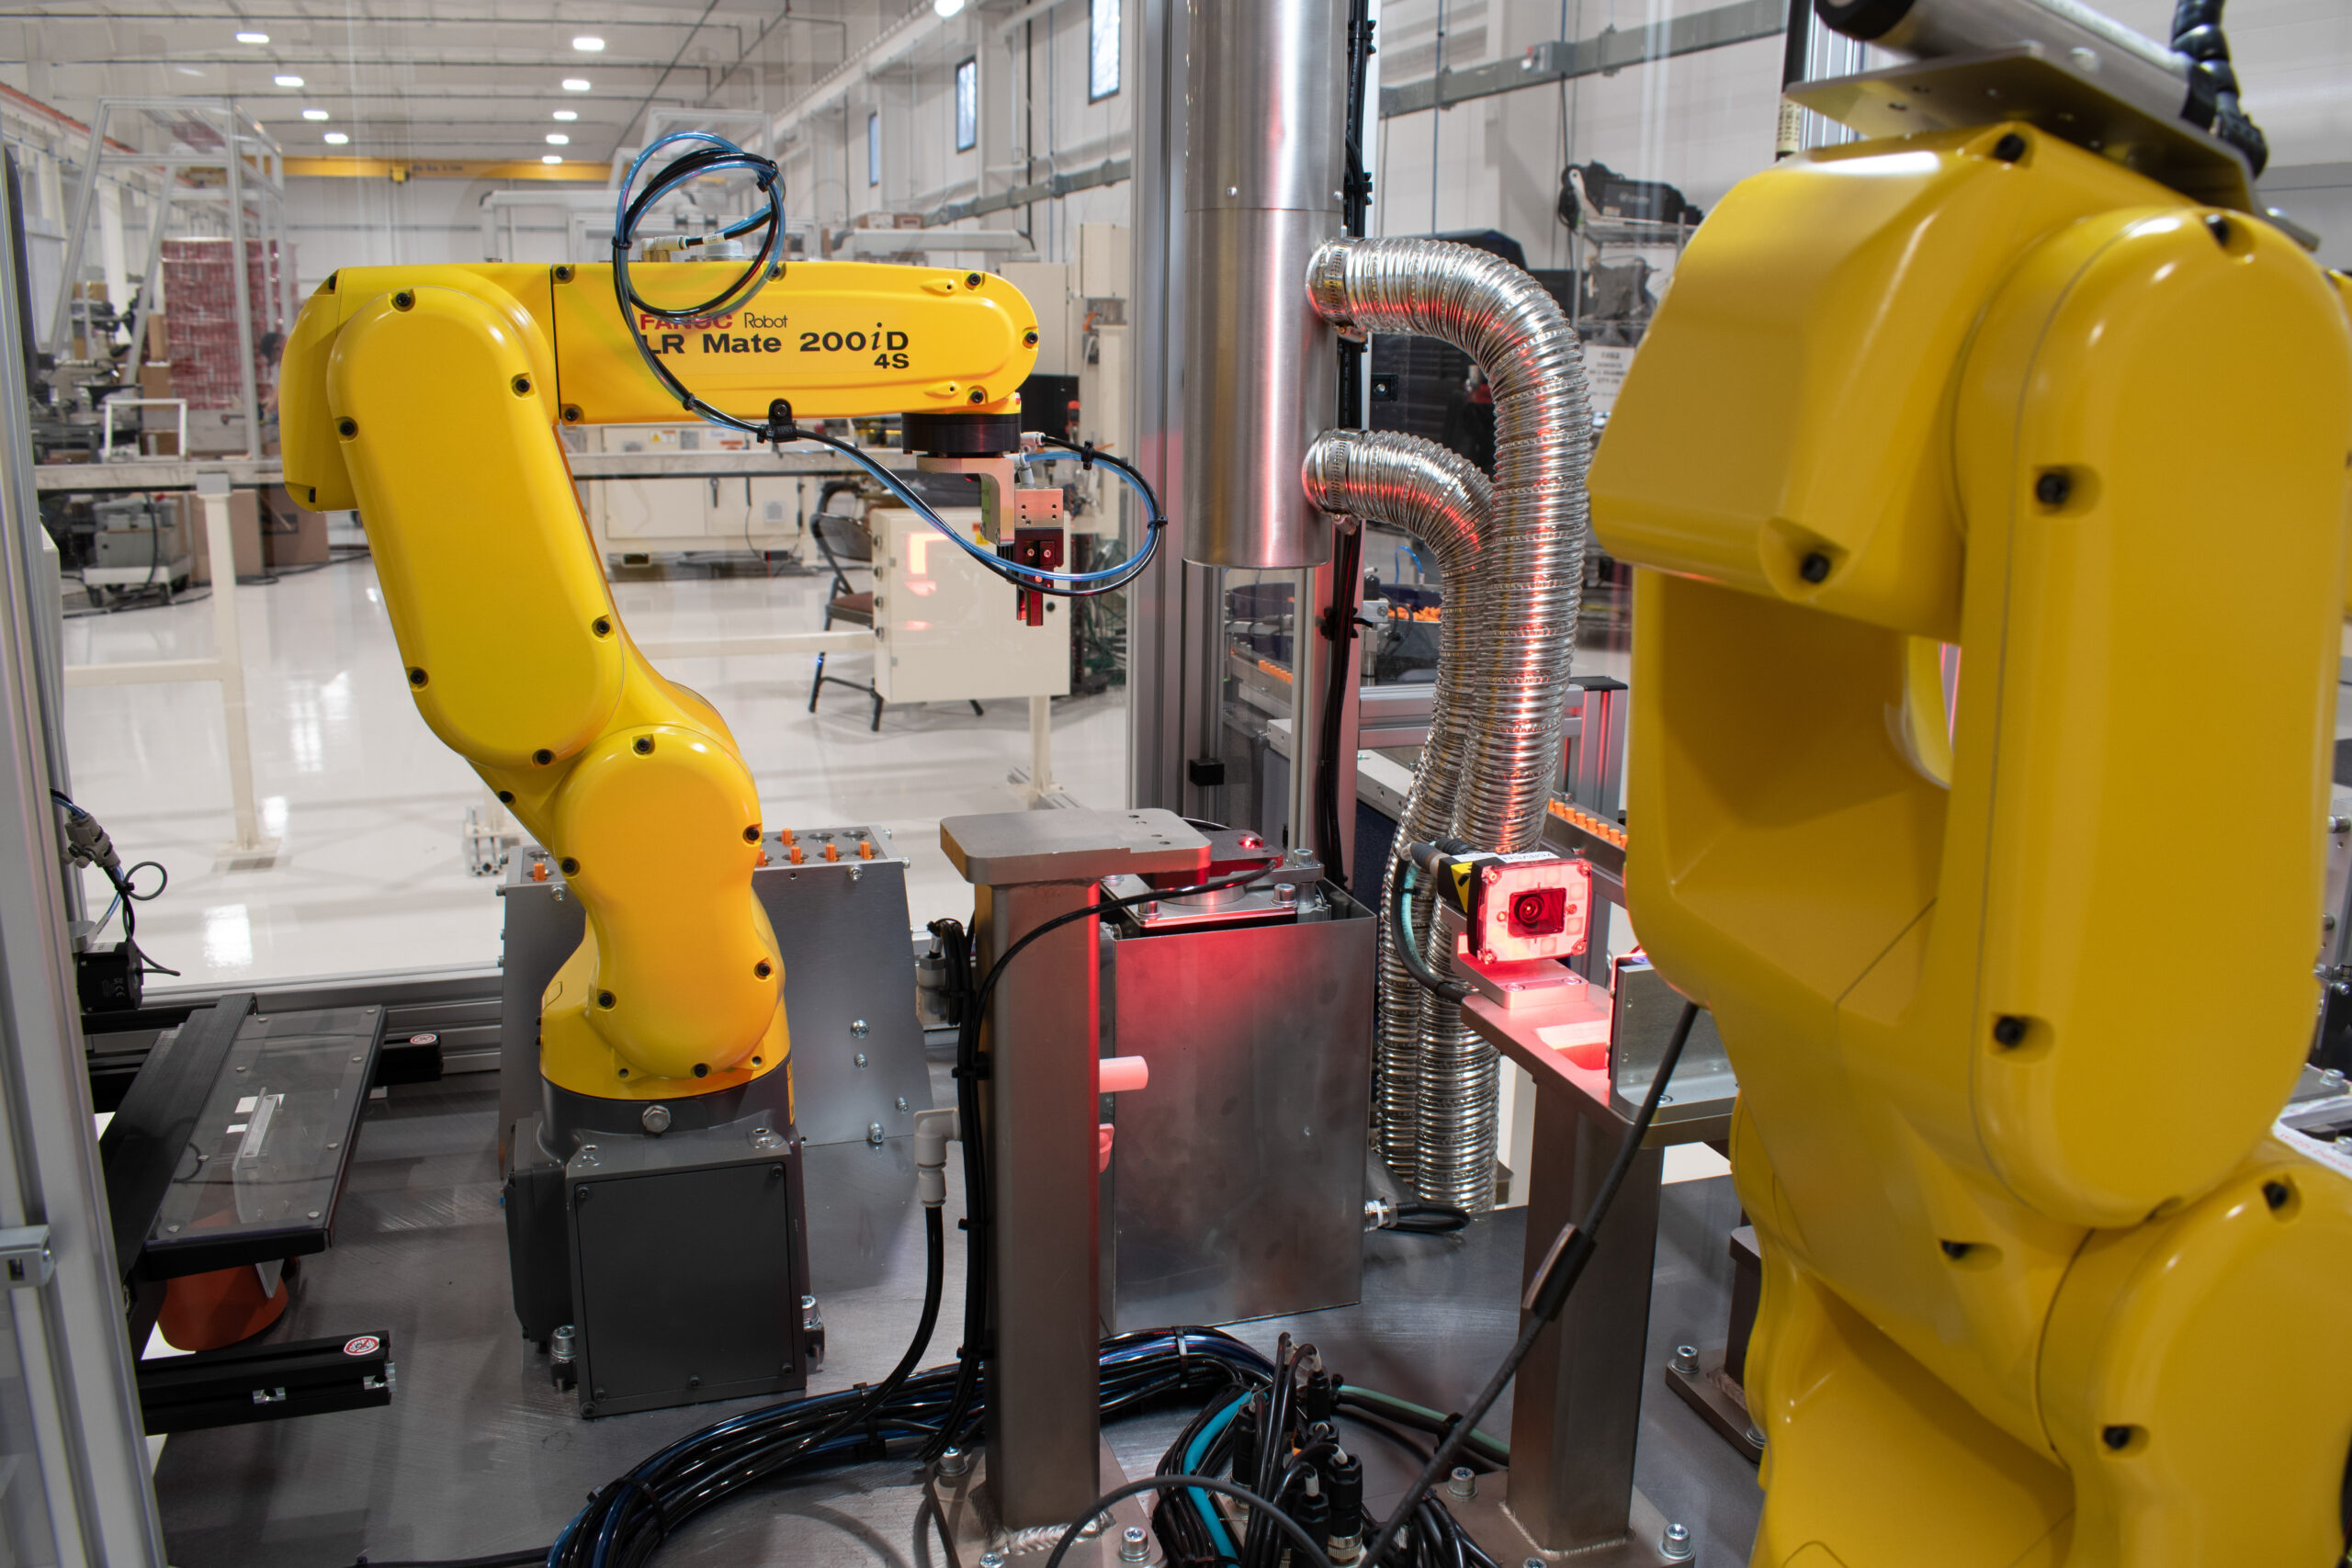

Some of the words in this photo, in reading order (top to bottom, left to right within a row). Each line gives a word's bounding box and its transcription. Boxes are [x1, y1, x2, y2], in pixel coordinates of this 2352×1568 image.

[744, 312, 788, 328] Robot
[640, 334, 685, 354] LR
[703, 333, 782, 354] Mate
[799, 321, 910, 352] 200iD
[874, 353, 910, 369] 4S
